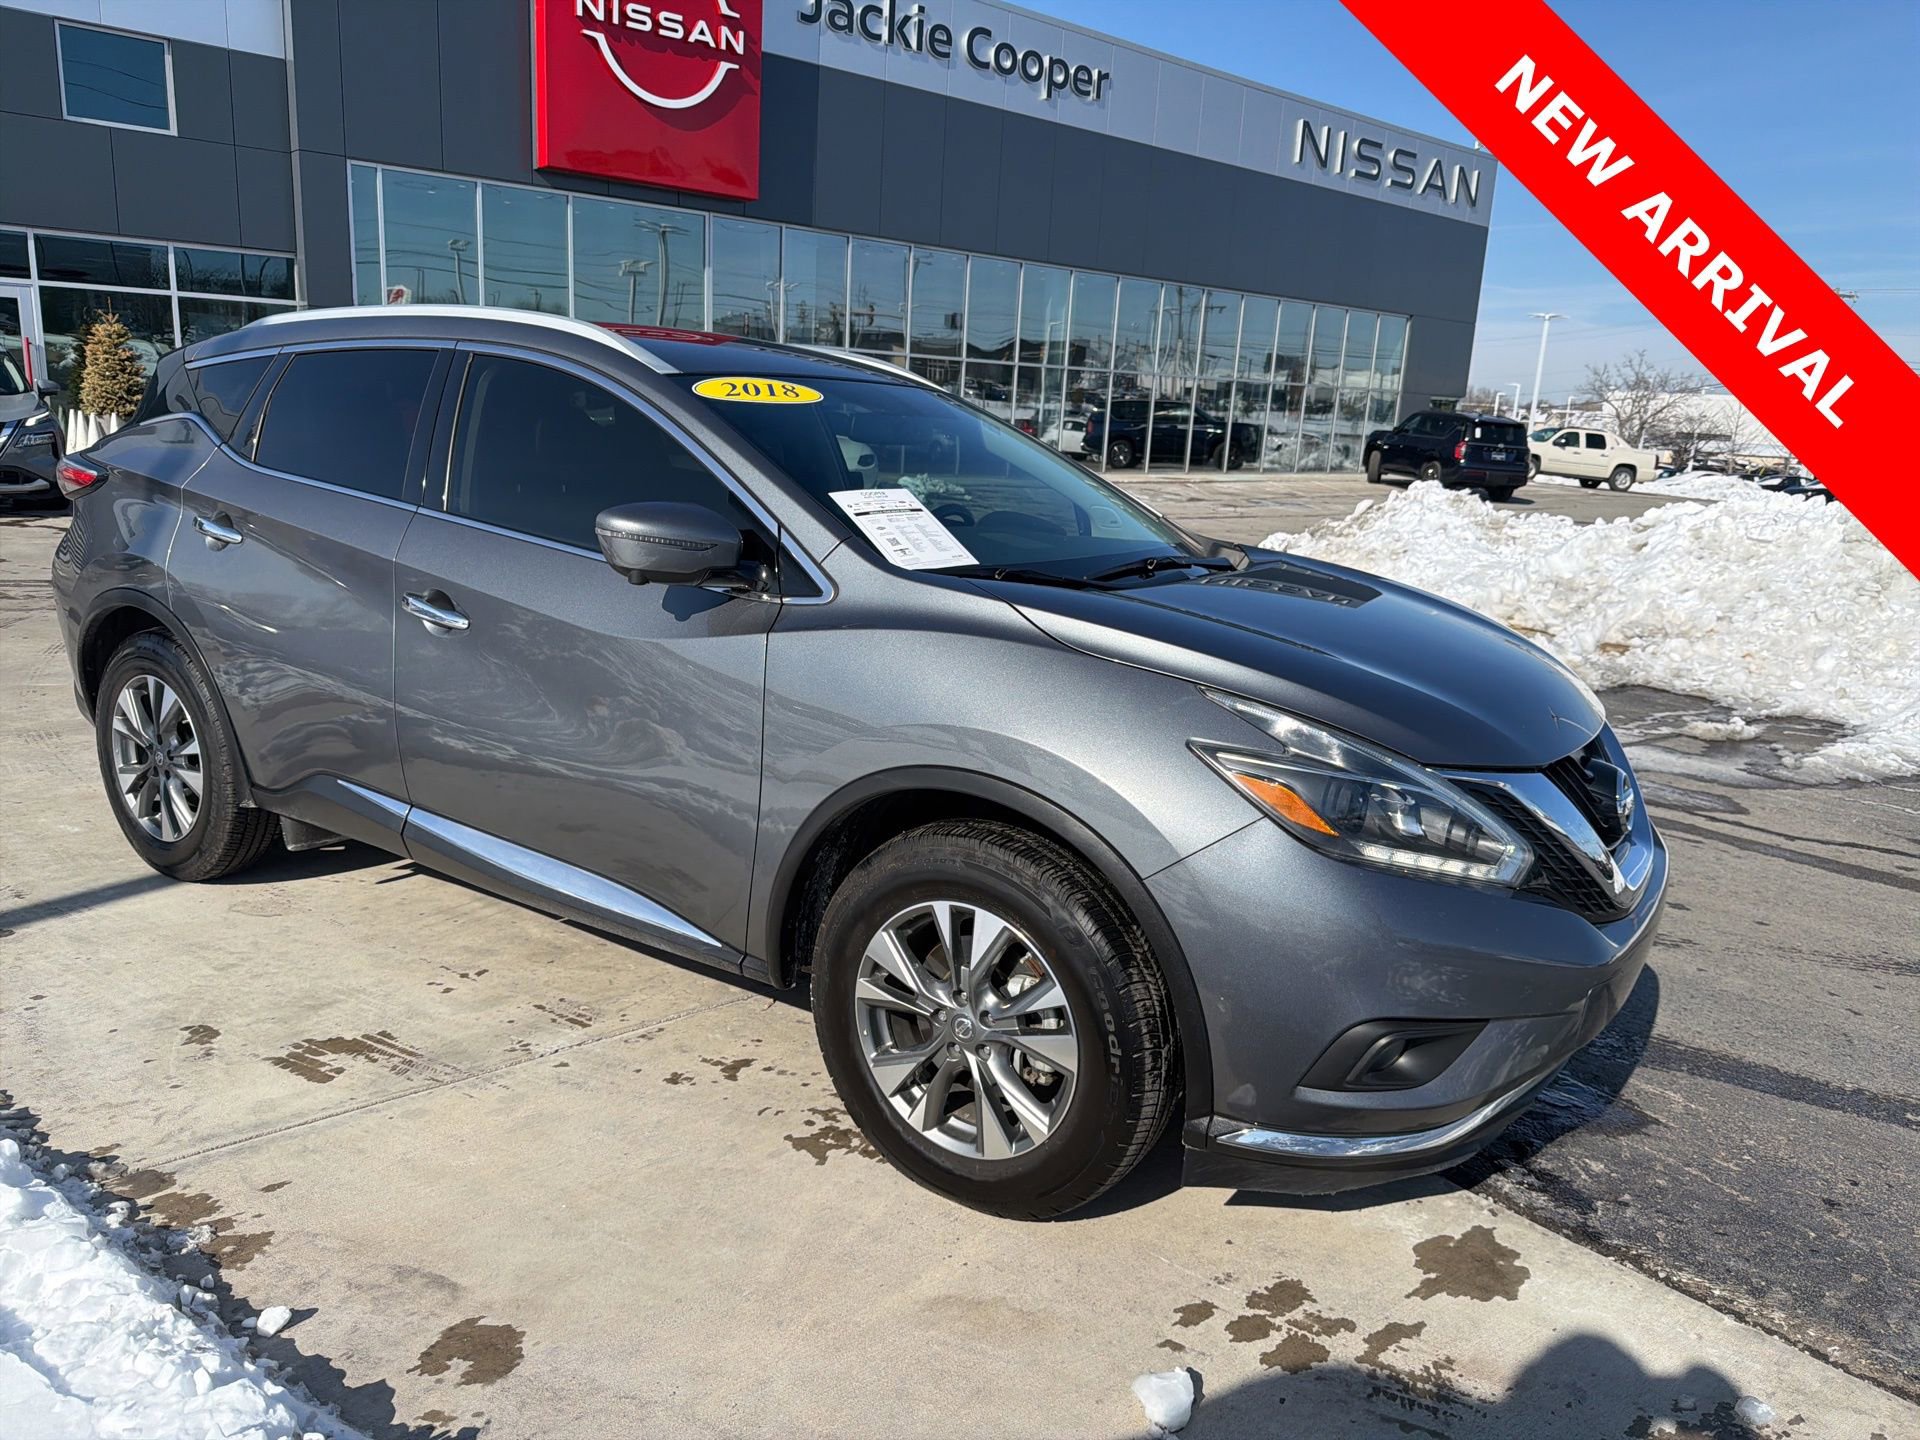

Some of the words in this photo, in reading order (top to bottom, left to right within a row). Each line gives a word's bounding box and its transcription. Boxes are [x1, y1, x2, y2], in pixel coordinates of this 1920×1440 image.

[574, 0, 744, 55] NISSAN
[799, 0, 953, 59] Jackie
[965, 26, 1110, 100] Cooper
[1294, 118, 1480, 207] NISSAN
[720, 382, 800, 398] 2018
